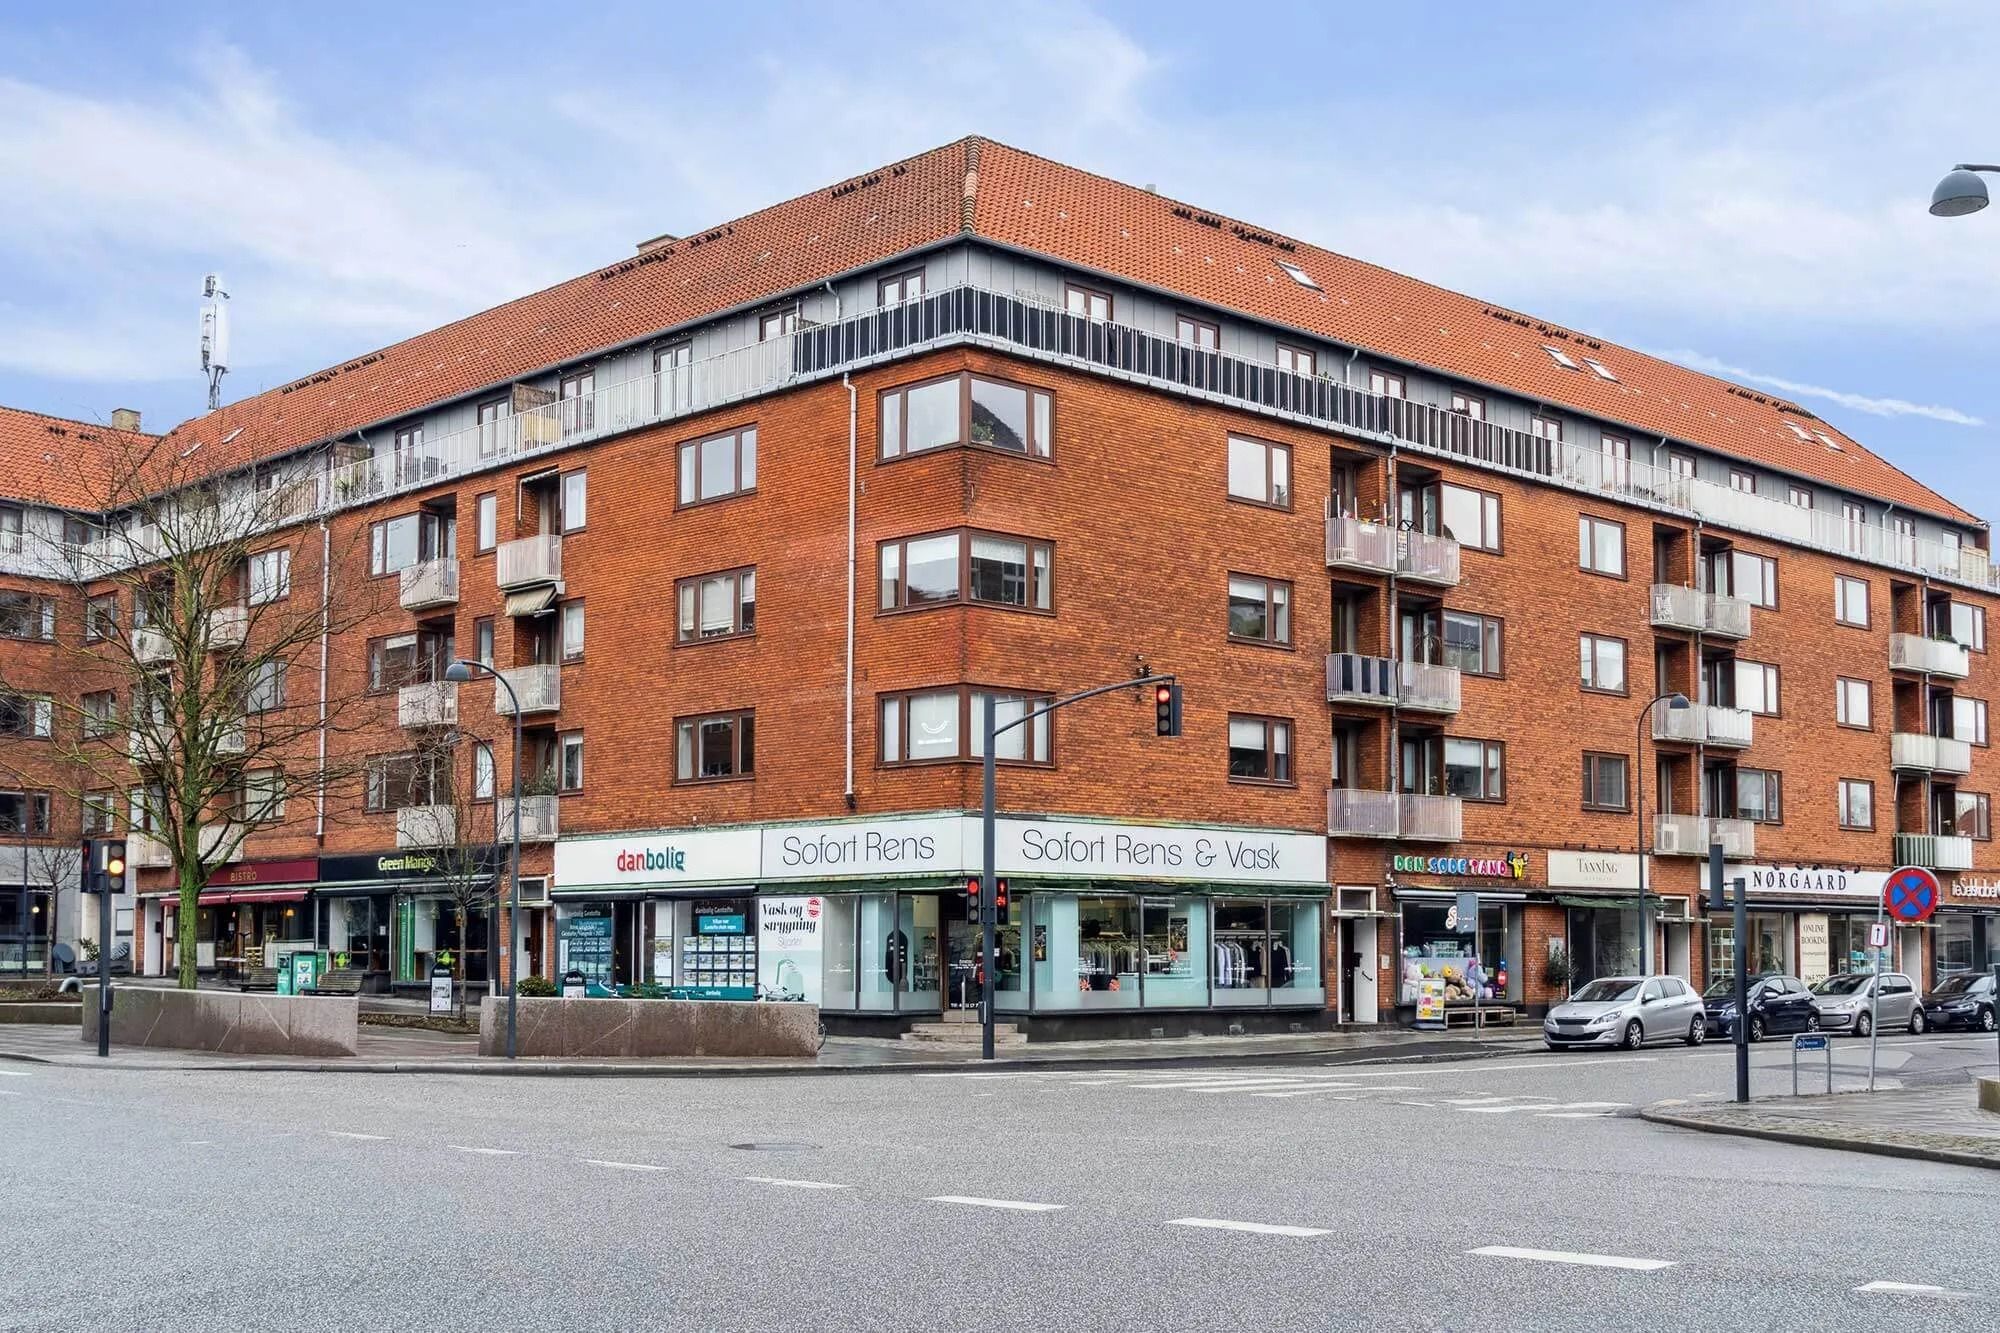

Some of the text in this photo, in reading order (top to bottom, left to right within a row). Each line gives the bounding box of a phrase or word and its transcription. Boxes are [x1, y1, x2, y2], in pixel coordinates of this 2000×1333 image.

[782, 831, 936, 866] Sofort Rens
[1022, 828, 1281, 870] Sofort Rens & Vask
[377, 856, 404, 872] Green
[616, 845, 686, 872] danbolig
[1394, 855, 1425, 872] DEN
[1469, 858, 1508, 876] TAND
[230, 871, 258, 882] BISTRO
[1753, 871, 1847, 891] NØRGAARD
[762, 901, 787, 916] Vask
[789, 905, 803, 918] og
[1803, 924, 1825, 933] ONLINE
[1801, 936, 1828, 945] BOOKING
